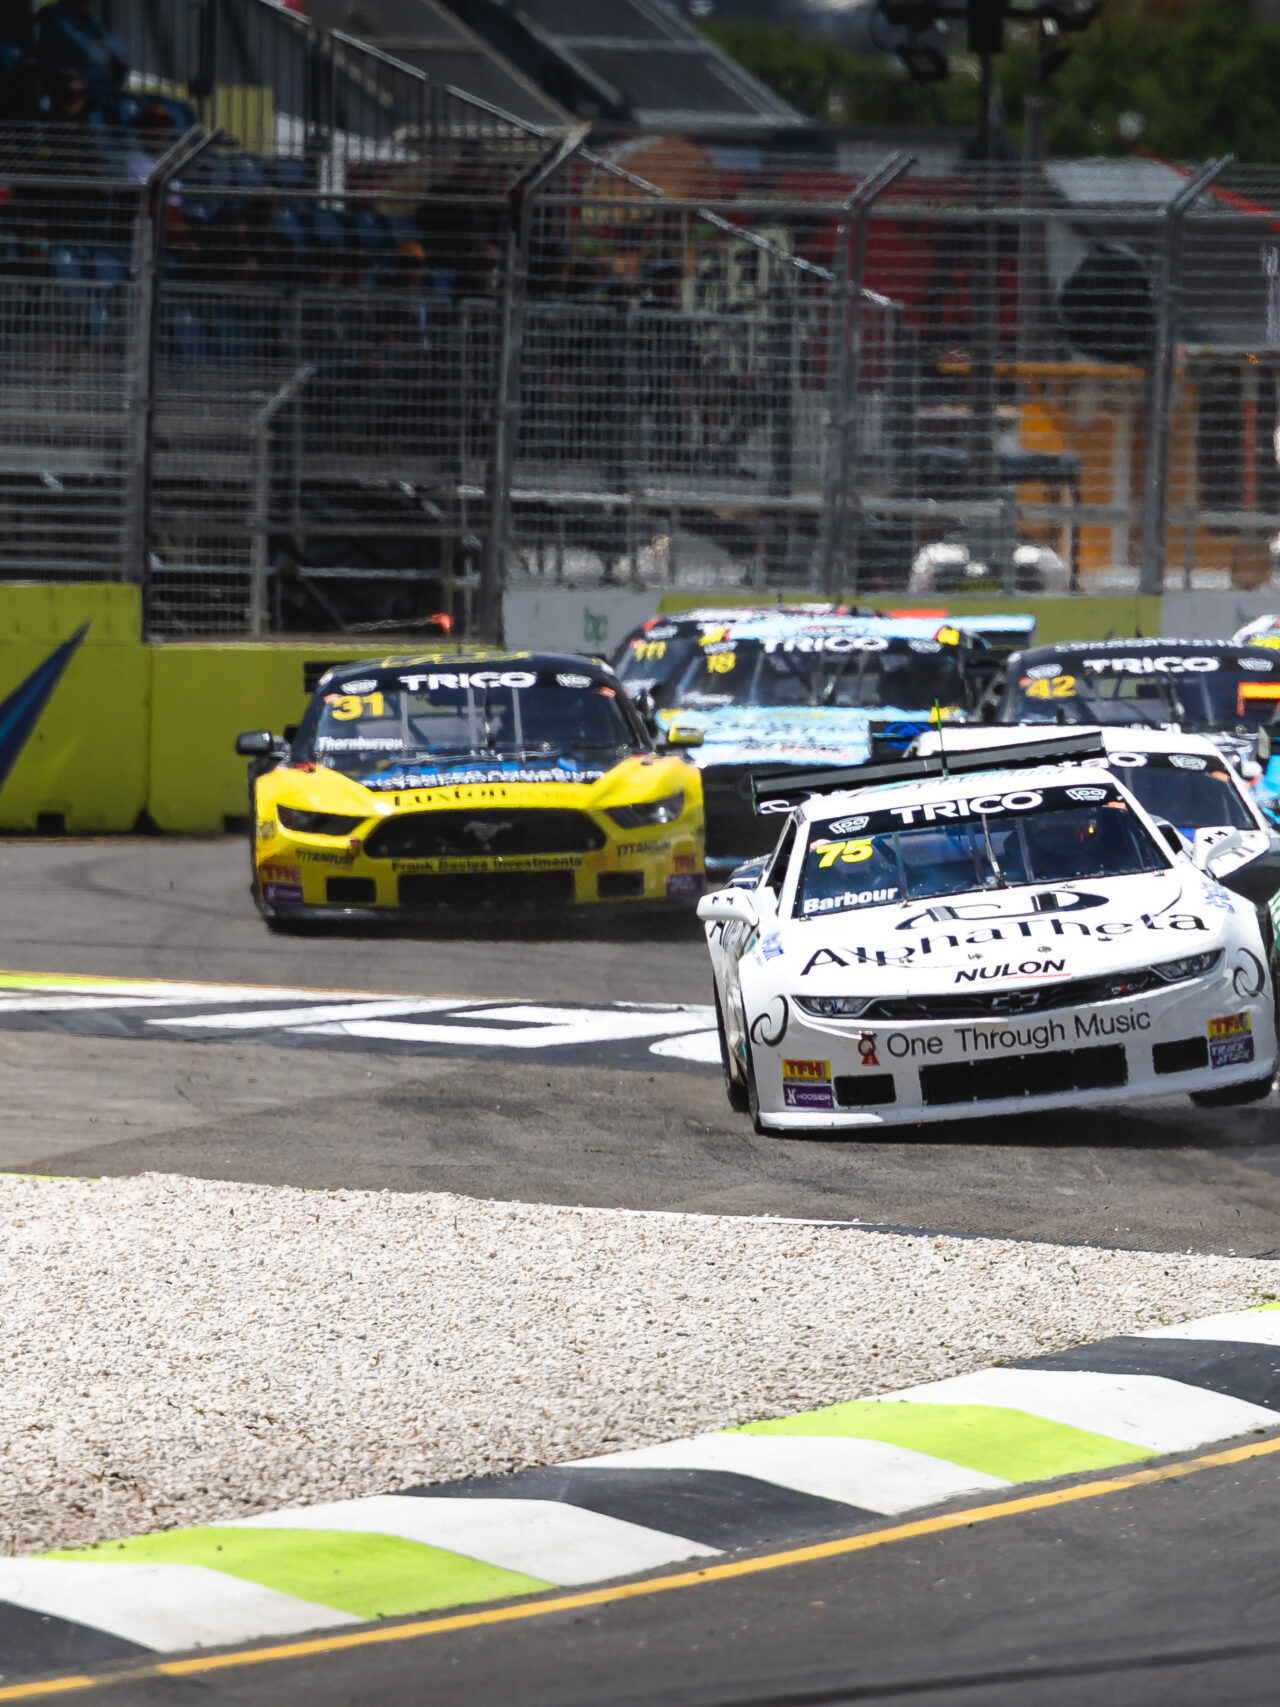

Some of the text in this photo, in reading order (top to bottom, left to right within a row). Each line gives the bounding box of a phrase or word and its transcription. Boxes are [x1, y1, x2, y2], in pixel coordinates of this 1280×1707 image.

[760, 636, 889, 653] TRICO
[1082, 657, 1220, 673] TRICO
[398, 671, 537, 691] TRICO
[1026, 675, 1076, 699] 42
[331, 692, 385, 721] 31
[891, 791, 1044, 824] TRICO
[816, 838, 873, 868] 75
[803, 886, 899, 914] Barbour
[801, 914, 1210, 976] AlphaTheta
[955, 960, 1067, 983] NULON
[887, 1009, 1151, 1058] One Through Music
